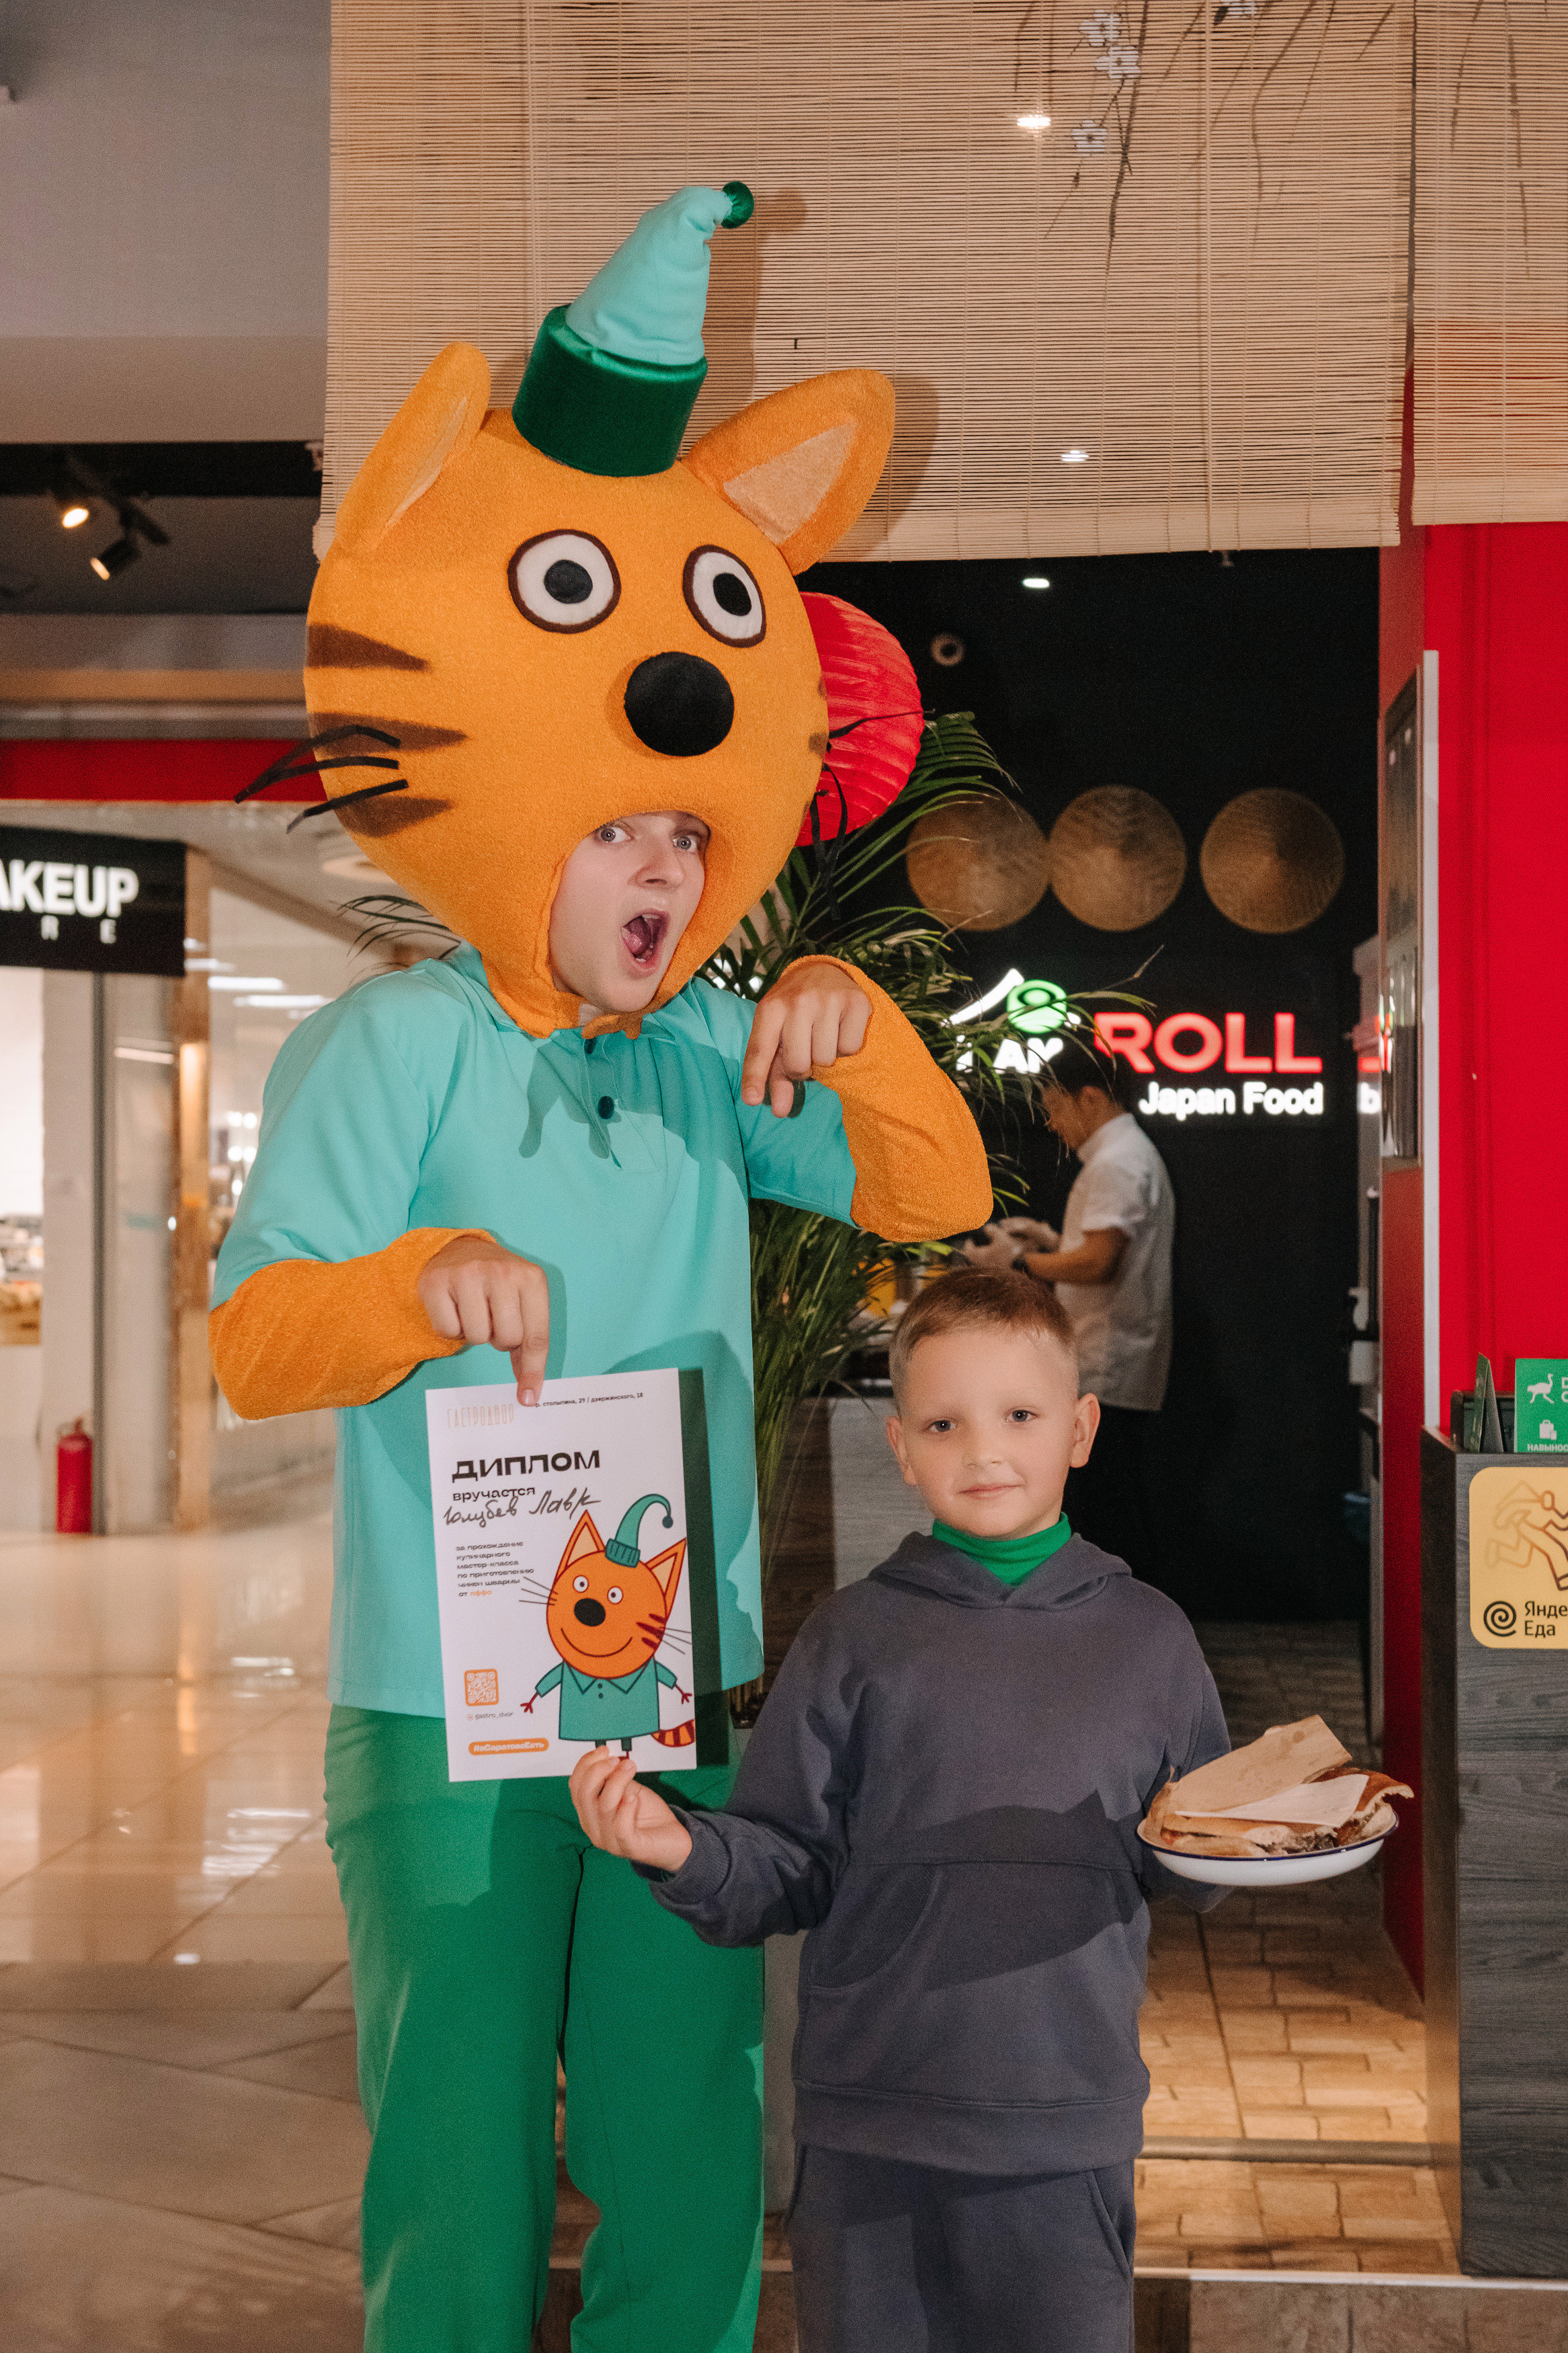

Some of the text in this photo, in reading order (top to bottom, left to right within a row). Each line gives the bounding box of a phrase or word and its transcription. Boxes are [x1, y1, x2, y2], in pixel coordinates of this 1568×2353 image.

[1094, 1012, 1323, 1074] ROLL
[1139, 1080, 1236, 1121] Japan
[1242, 1080, 1324, 1115] Food
[466, 1542, 524, 1551] прохождение
[456, 1552, 511, 1561] кулинарного
[469, 1568, 534, 1579] приготовлению
[1524, 1620, 1556, 1638] Еда
